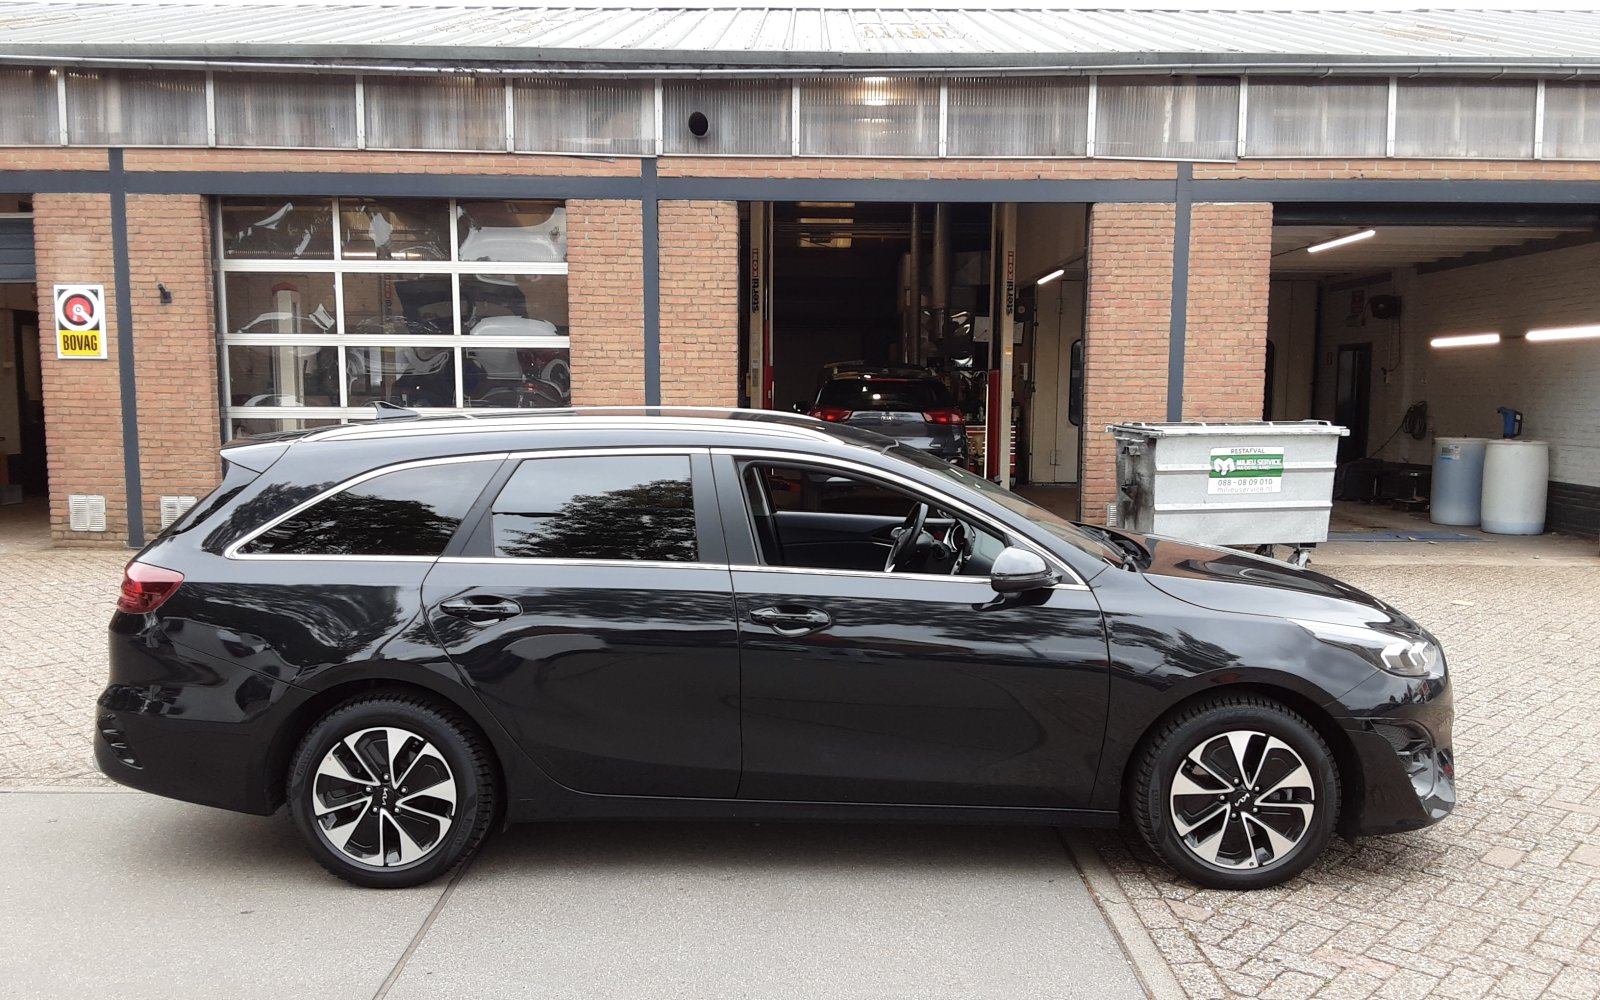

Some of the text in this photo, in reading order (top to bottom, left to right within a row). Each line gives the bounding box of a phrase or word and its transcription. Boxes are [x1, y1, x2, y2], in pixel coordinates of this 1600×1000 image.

[752, 278, 760, 313] stertil
[1006, 281, 1014, 316] stertil
[62, 334, 98, 352] BOVAG
